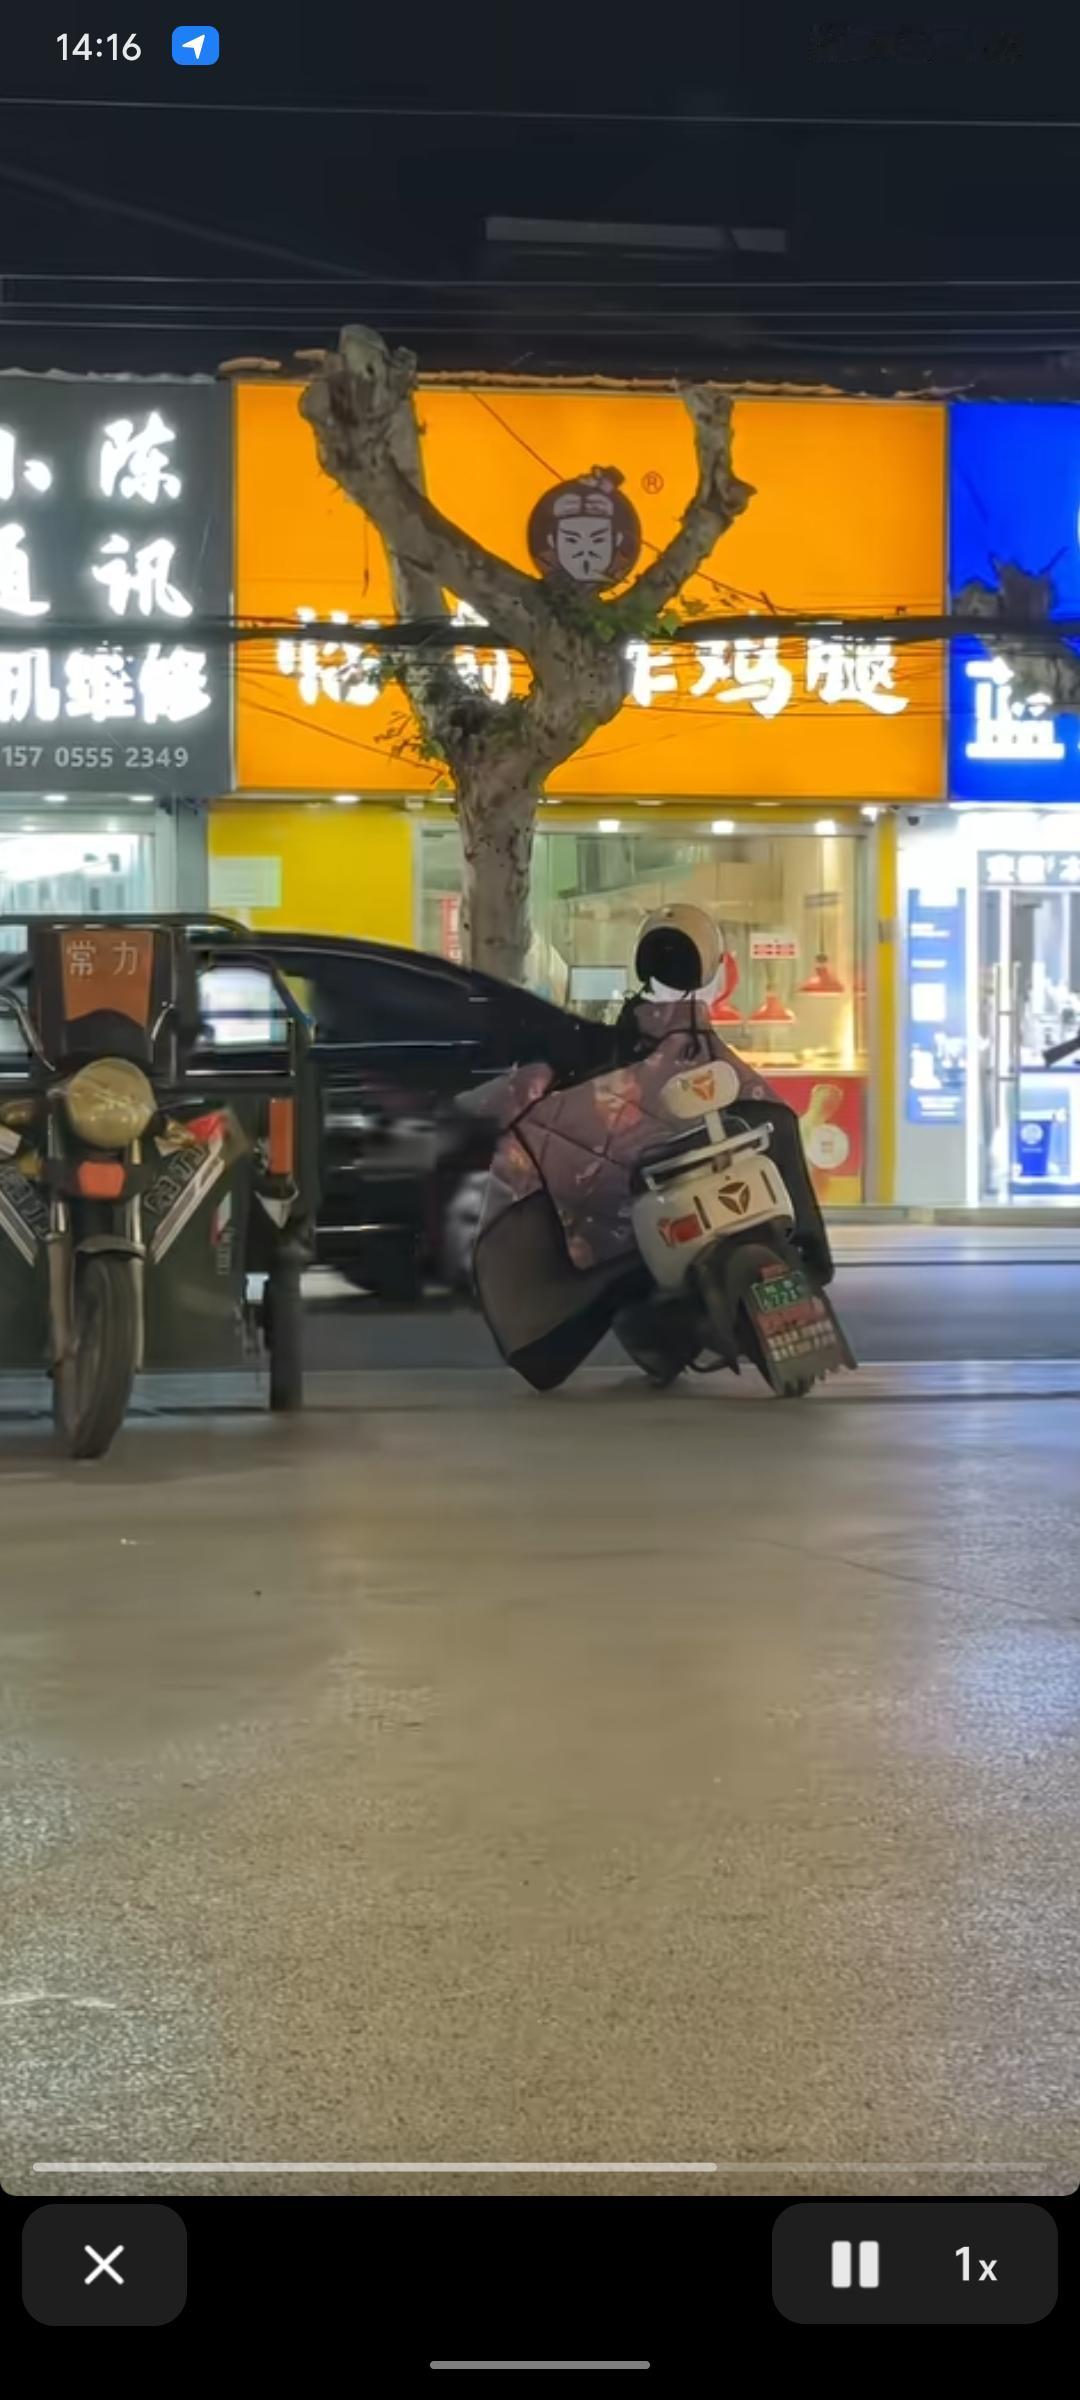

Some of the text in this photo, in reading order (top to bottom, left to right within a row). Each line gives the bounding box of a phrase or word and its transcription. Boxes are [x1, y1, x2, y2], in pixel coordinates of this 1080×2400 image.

[2, 746, 188, 767] 157 0555 2349
[66, 939, 139, 976] 常力
